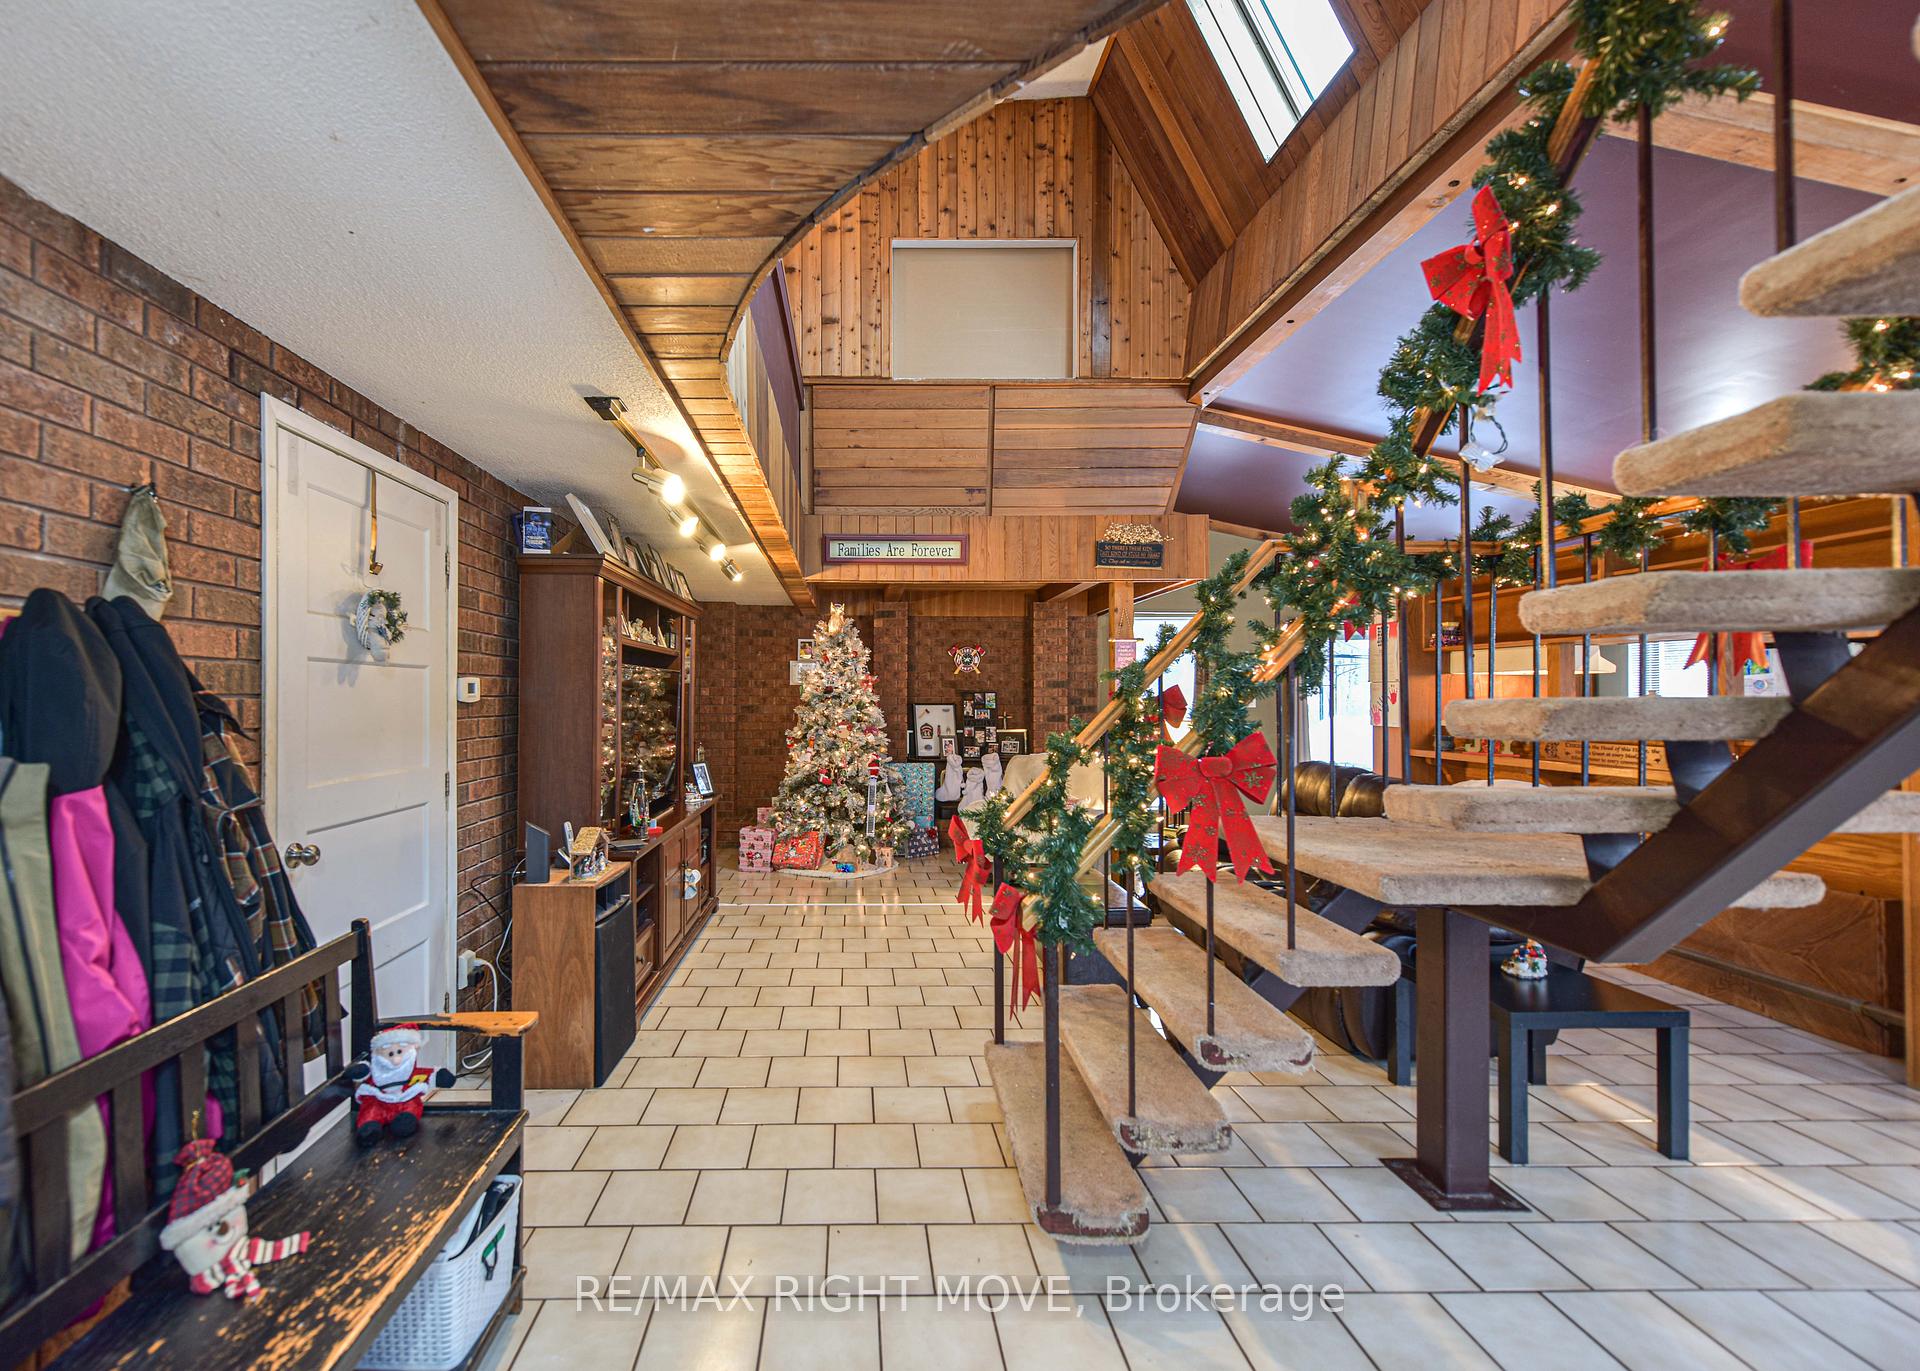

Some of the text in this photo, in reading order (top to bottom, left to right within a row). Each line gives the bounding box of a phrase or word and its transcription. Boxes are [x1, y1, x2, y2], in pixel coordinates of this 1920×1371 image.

[838, 543, 954, 557] Families Are Forever
